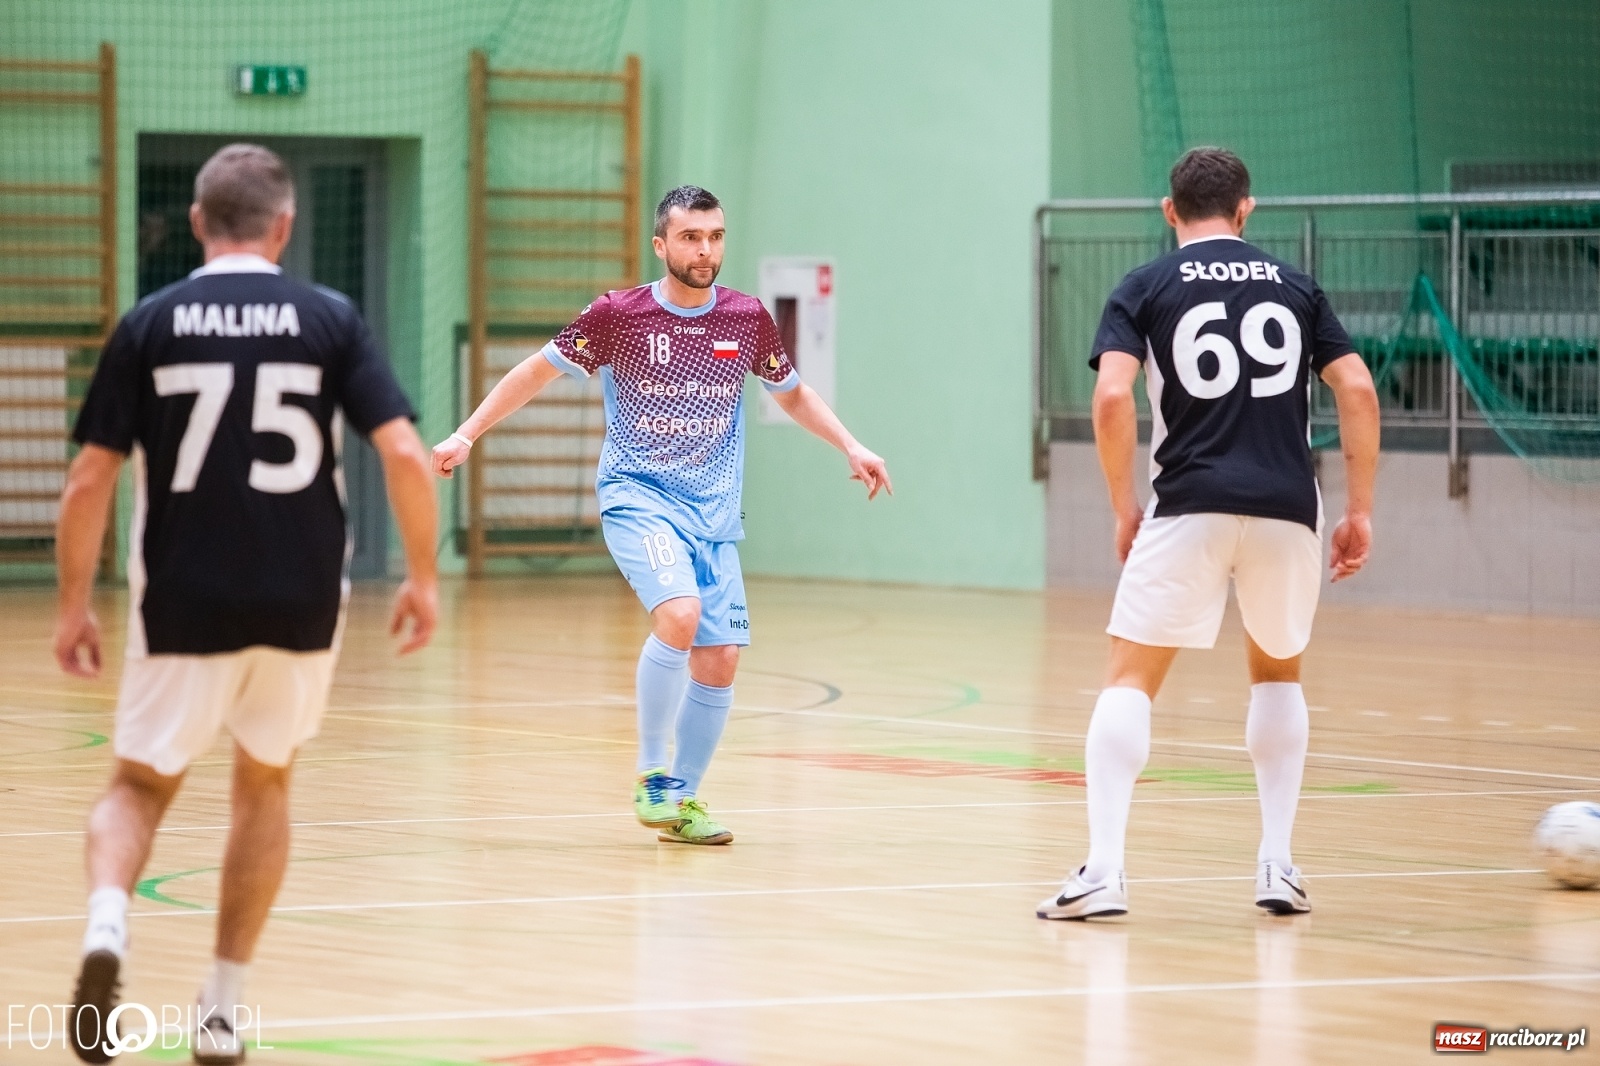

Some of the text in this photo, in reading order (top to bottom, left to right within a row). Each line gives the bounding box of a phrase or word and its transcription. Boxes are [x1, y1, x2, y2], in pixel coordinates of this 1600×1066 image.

[1179, 261, 1282, 284] SŁODEK
[173, 302, 300, 337] MALINA
[646, 333, 671, 365] 18
[1172, 301, 1302, 400] 69
[152, 361, 324, 495] 75
[641, 531, 677, 573] 18
